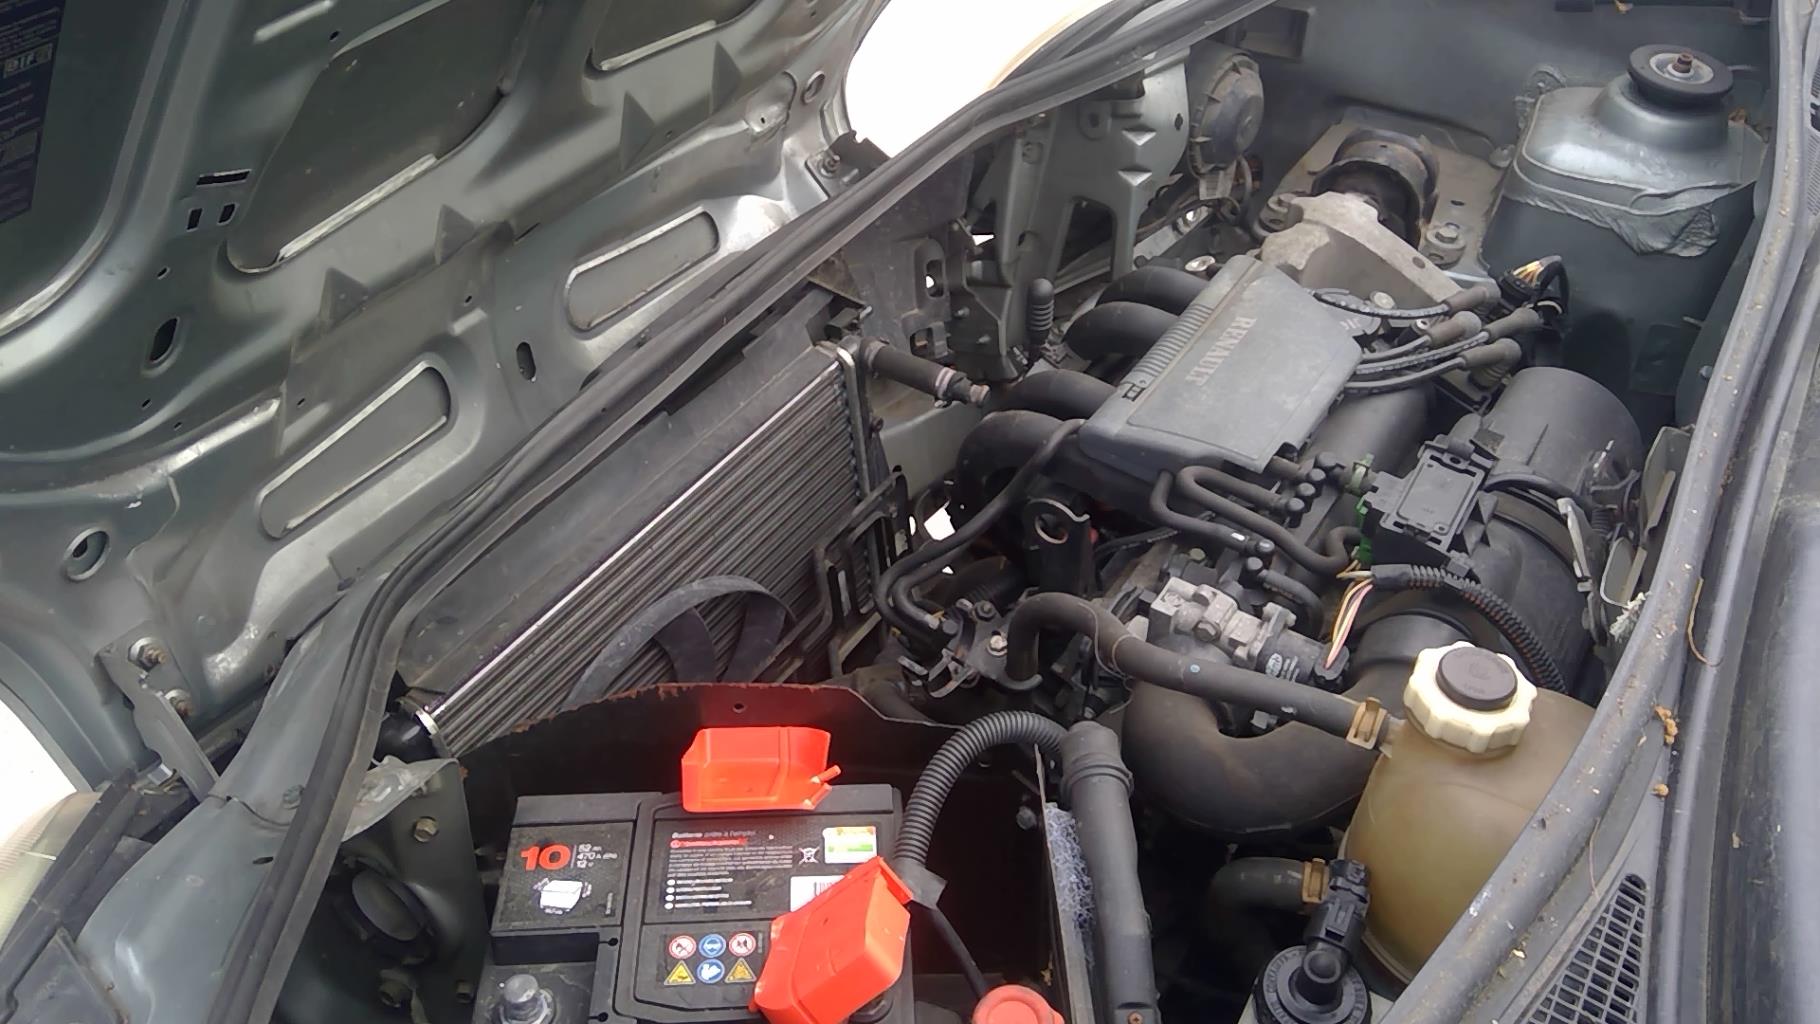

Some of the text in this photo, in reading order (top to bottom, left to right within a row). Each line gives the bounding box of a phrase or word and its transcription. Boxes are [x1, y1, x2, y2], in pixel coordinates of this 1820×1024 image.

[1185, 316, 1258, 387] RENAULT
[520, 842, 571, 871] 10
[577, 852, 596, 860] 470
